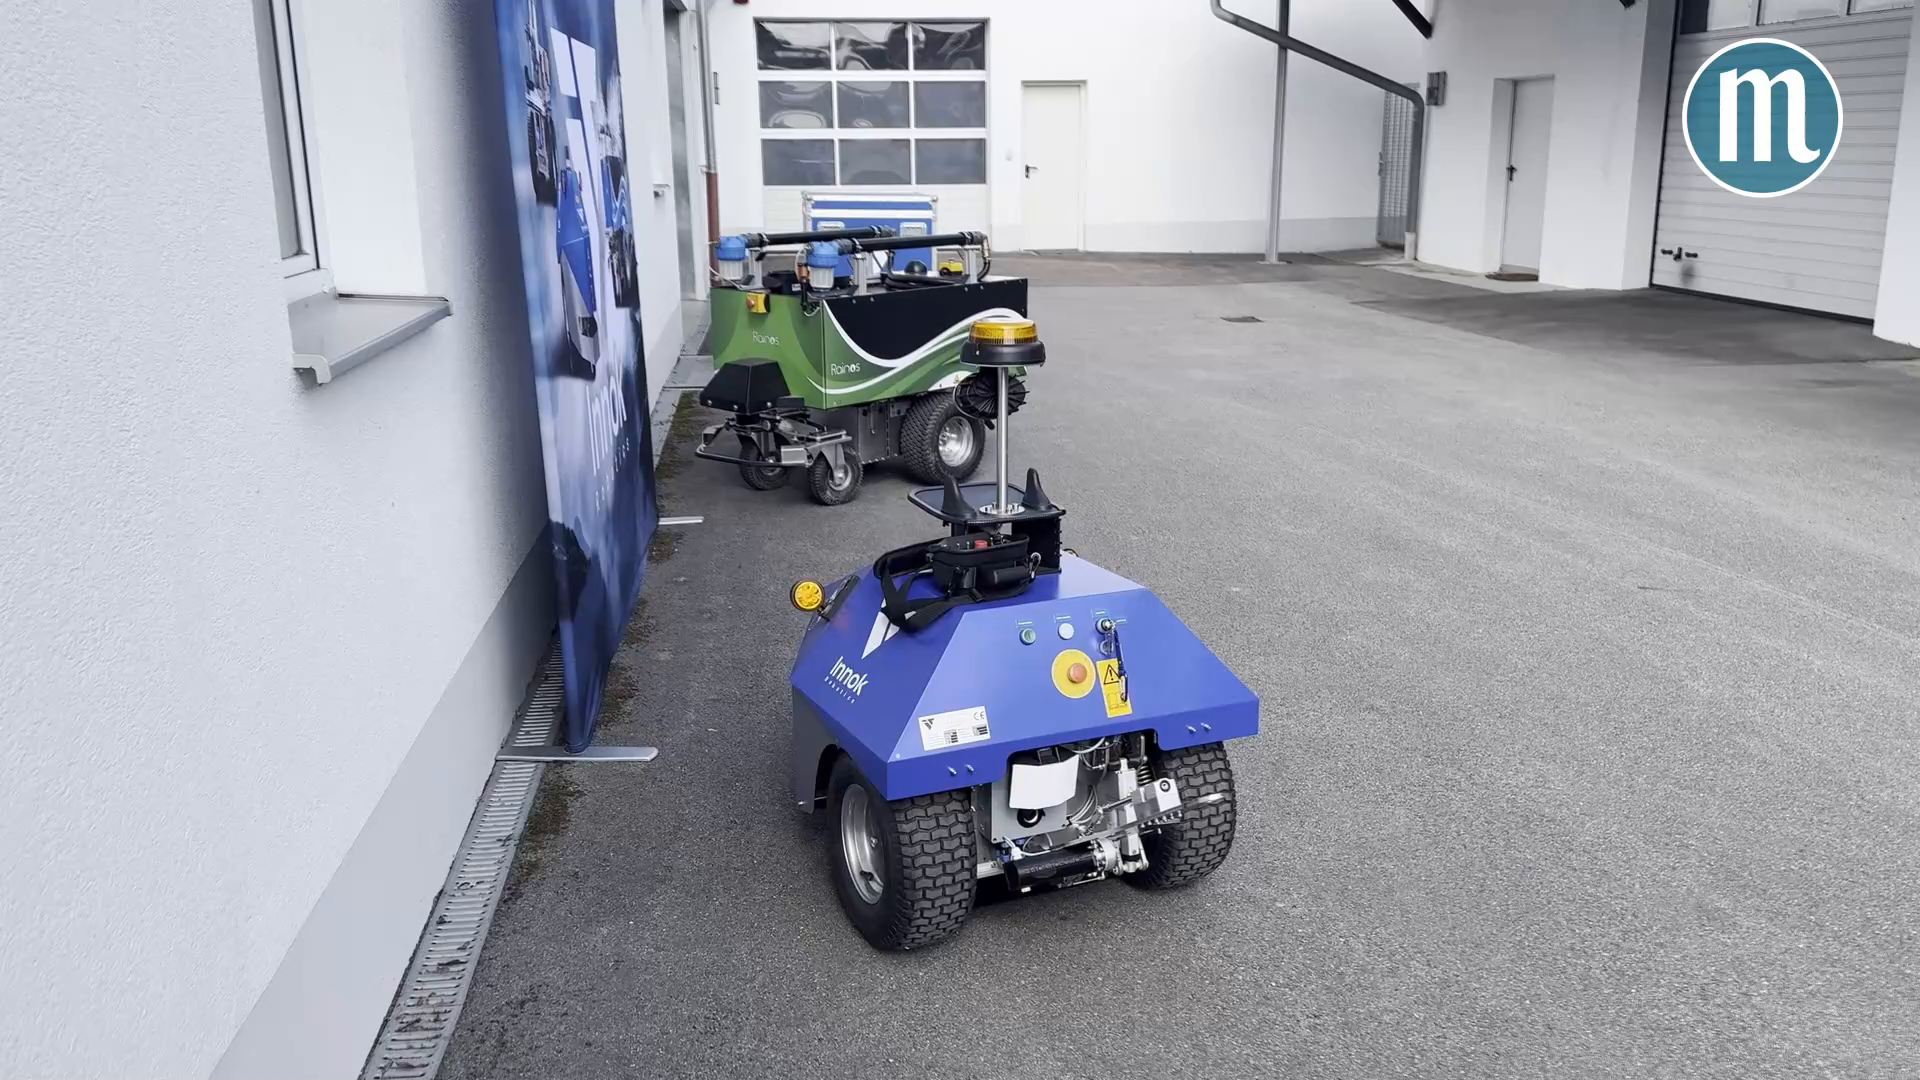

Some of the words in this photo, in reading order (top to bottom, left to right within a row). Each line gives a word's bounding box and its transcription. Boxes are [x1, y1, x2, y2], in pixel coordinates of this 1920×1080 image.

[830, 362, 861, 376] Rainos
[586, 344, 627, 477] Innok
[829, 655, 869, 697] Innok
